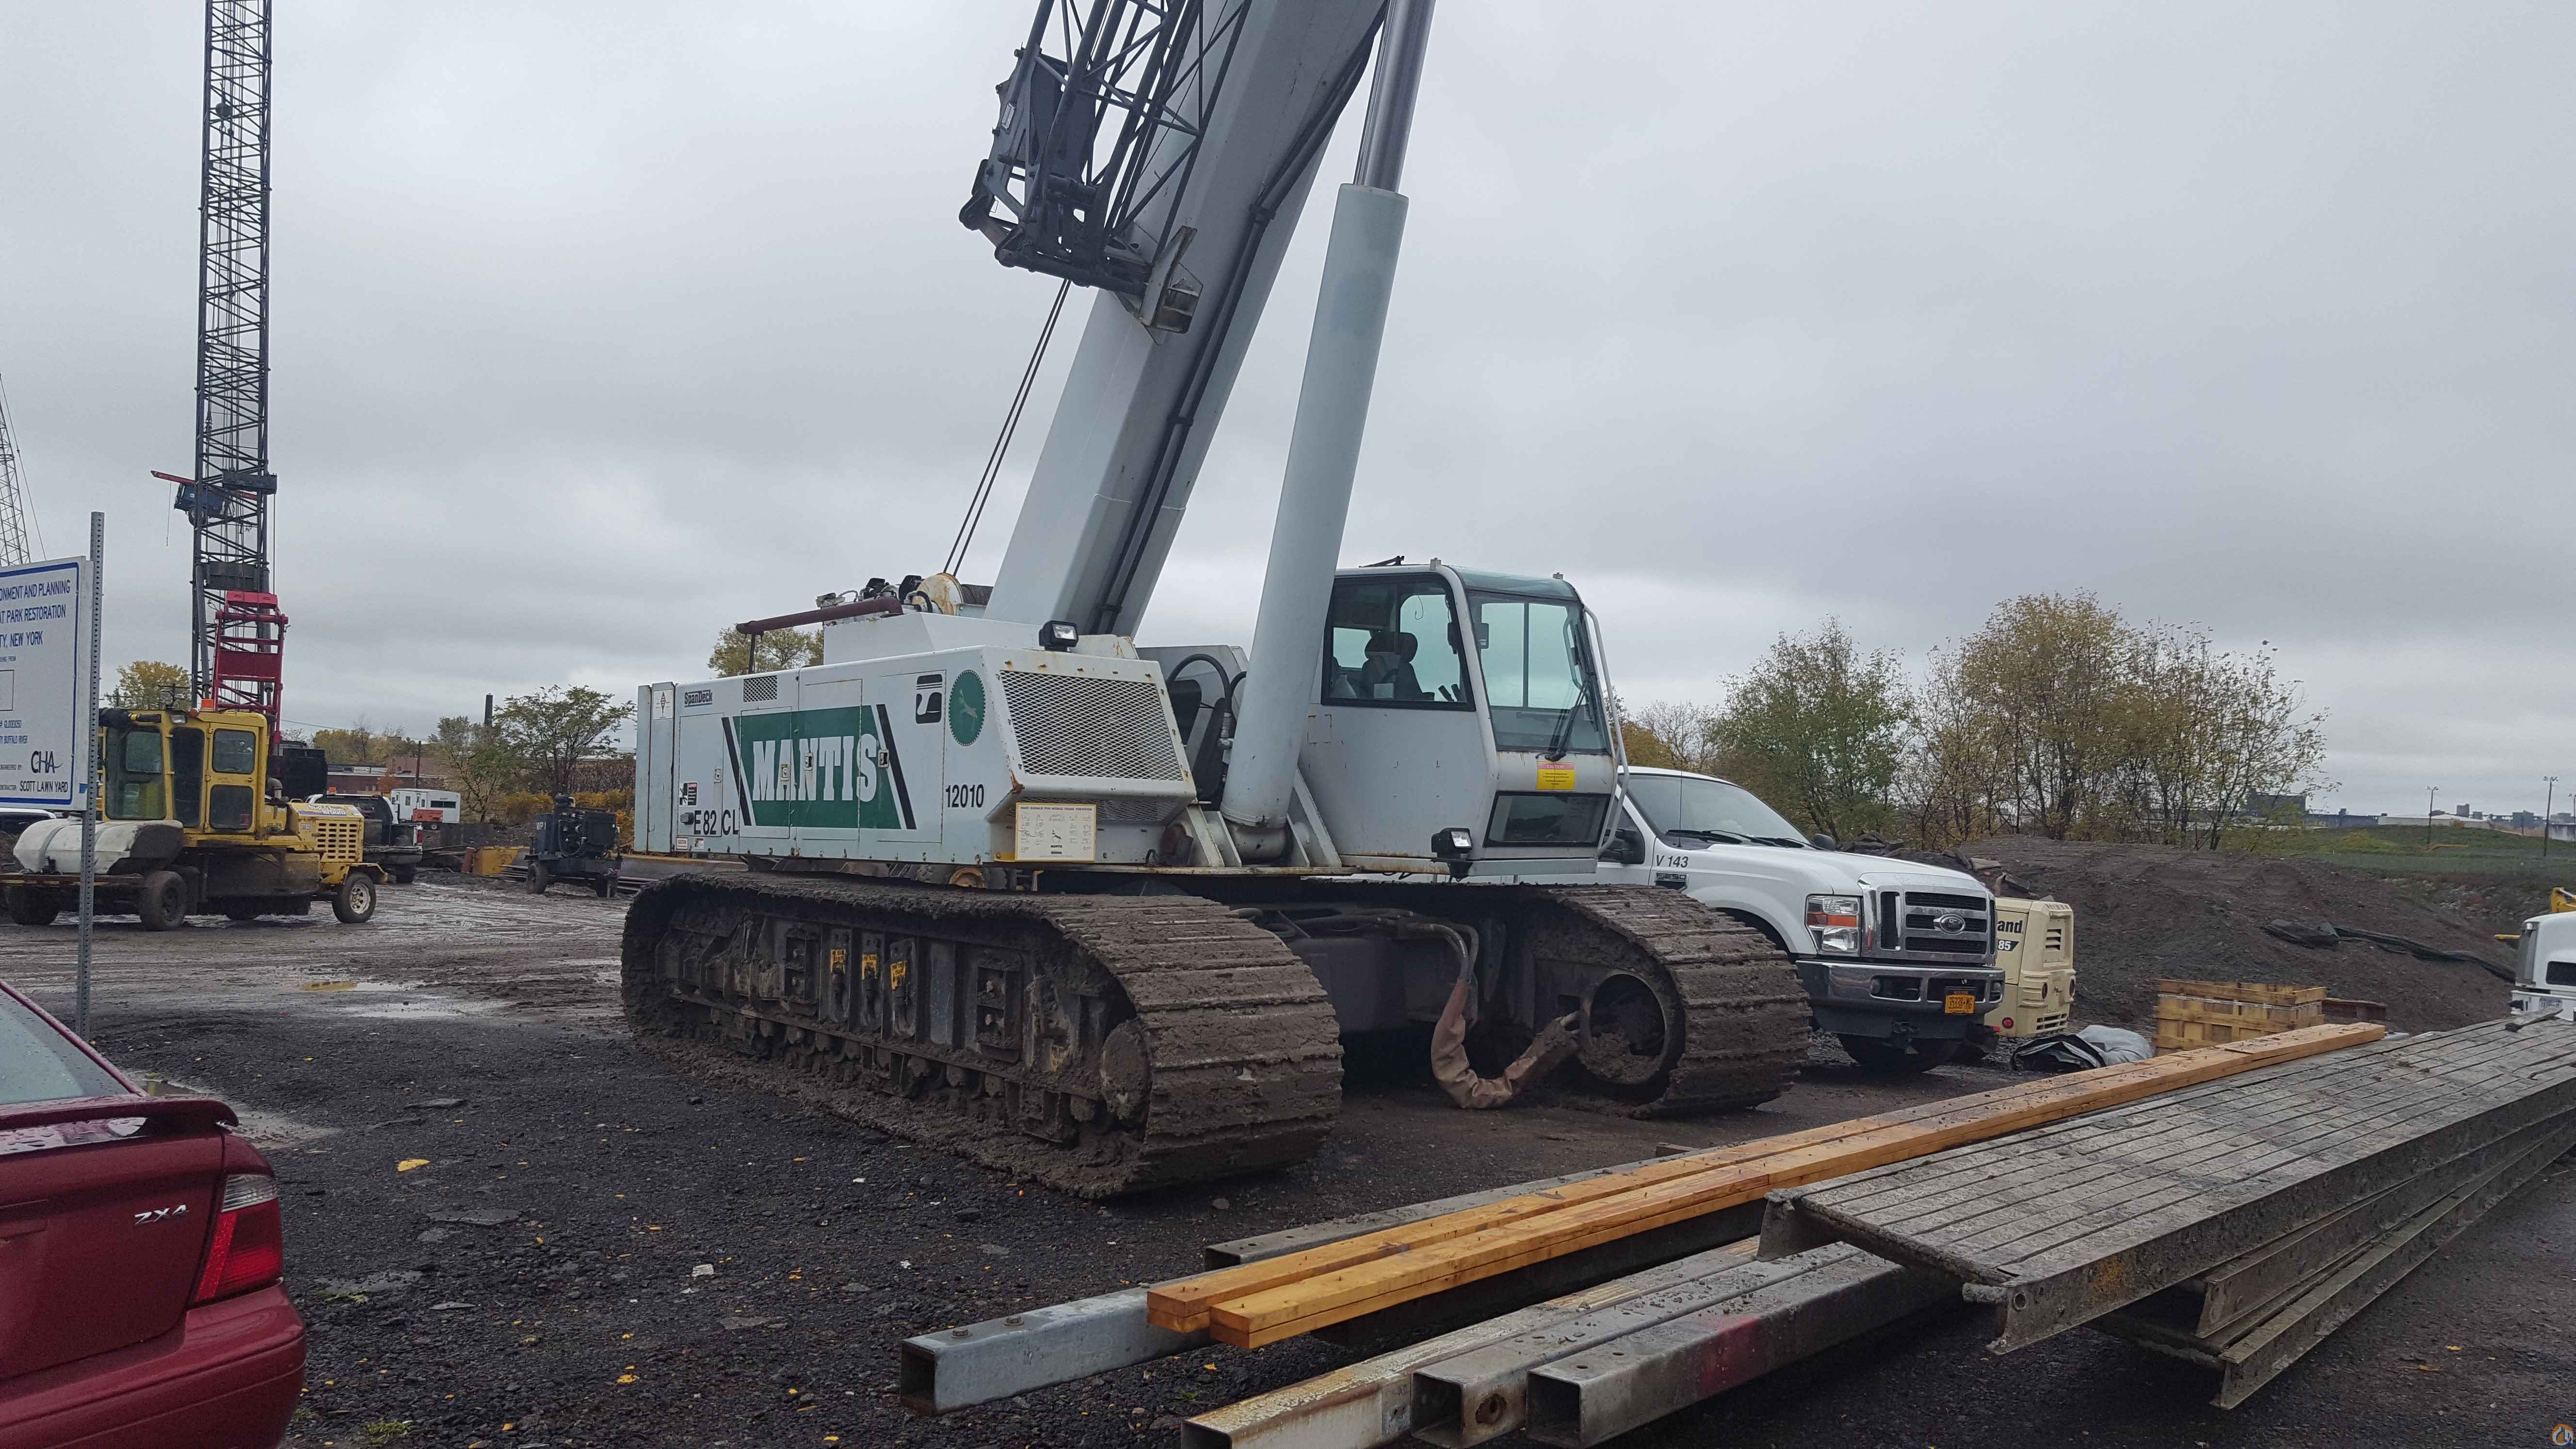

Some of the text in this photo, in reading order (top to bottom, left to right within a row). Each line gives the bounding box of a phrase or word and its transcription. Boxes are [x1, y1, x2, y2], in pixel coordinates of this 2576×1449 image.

[24, 584, 37, 598] AND
[39, 580, 70, 596] PLANNING
[7, 609, 23, 623] PARK
[25, 604, 66, 621] RESTORATION
[10, 632, 24, 647] NEW
[26, 631, 43, 645] YORK
[684, 690, 712, 707] SpanDeck
[31, 751, 57, 773] CHA
[753, 733, 877, 802] MANTIS
[20, 780, 35, 792] SCOTT
[37, 781, 53, 792] LAWN
[54, 782, 68, 792] YARD
[946, 784, 984, 808] 12010
[694, 809, 740, 835] E82 CL
[1657, 855, 1689, 868] V 143
[1997, 920, 2023, 934] and
[1998, 940, 2011, 950] 85
[135, 1204, 190, 1226] ZX4
